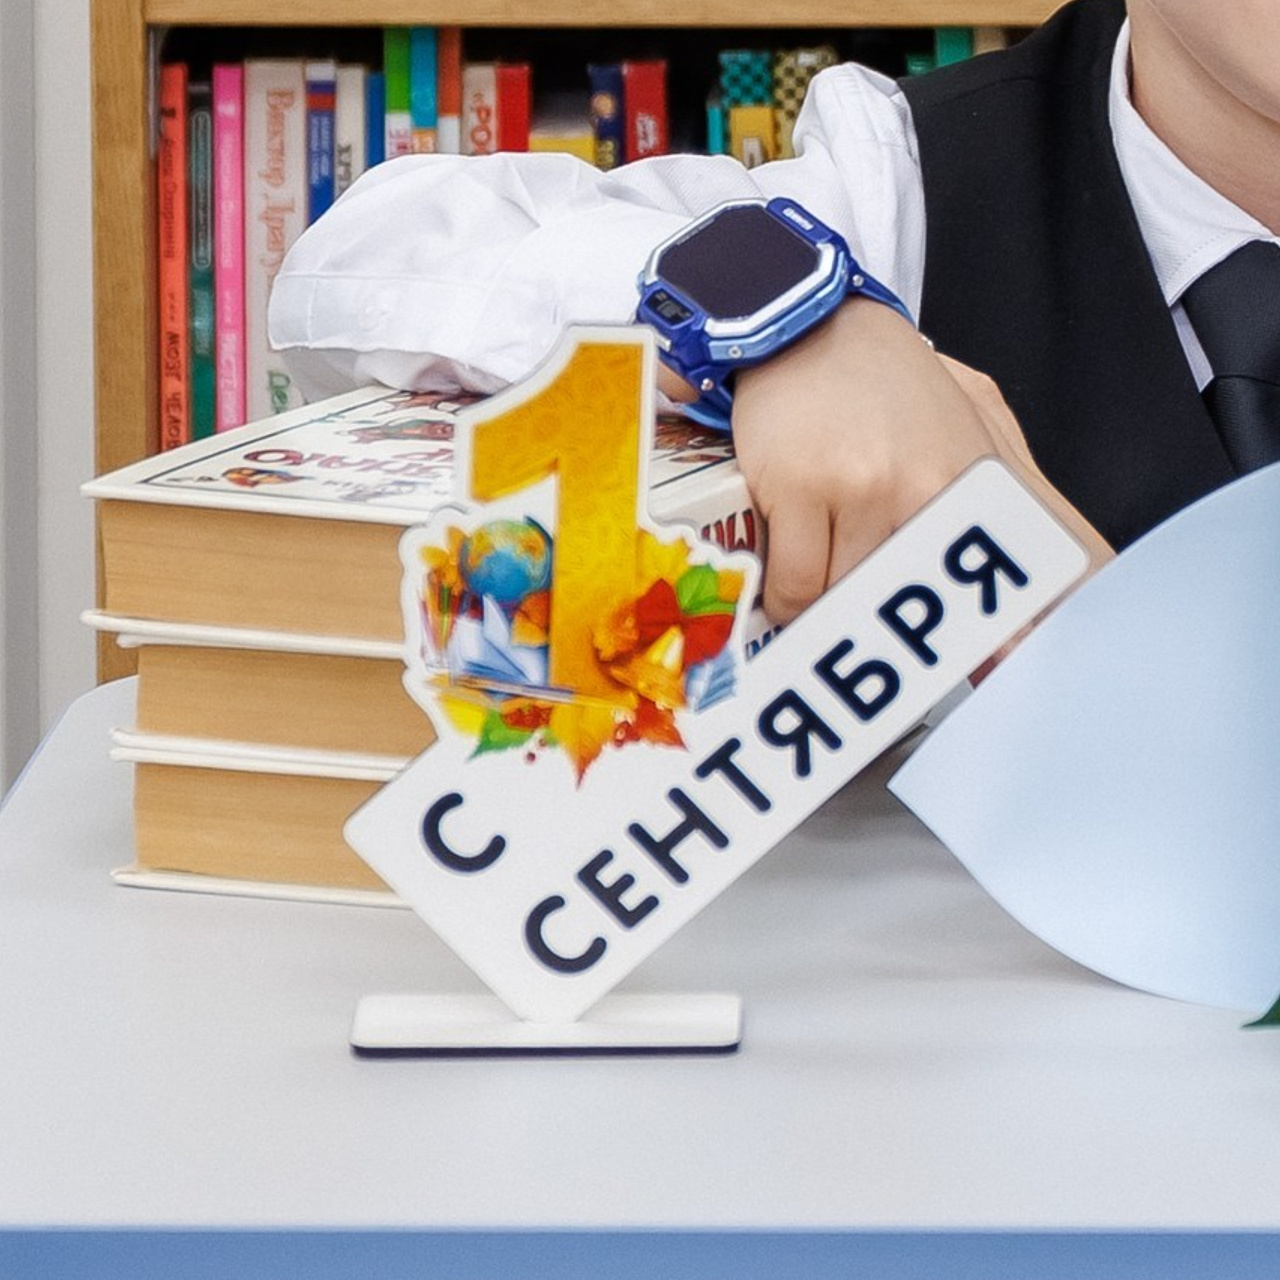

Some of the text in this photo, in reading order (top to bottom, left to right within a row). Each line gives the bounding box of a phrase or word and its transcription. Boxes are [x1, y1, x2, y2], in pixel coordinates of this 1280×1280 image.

[258, 89, 296, 187] Виктор
[166, 331, 181, 382] МОЗГ
[471, 341, 644, 688] 1
[521, 525, 1030, 976] СЕНТЯБРЯ
[420, 791, 508, 874] С
